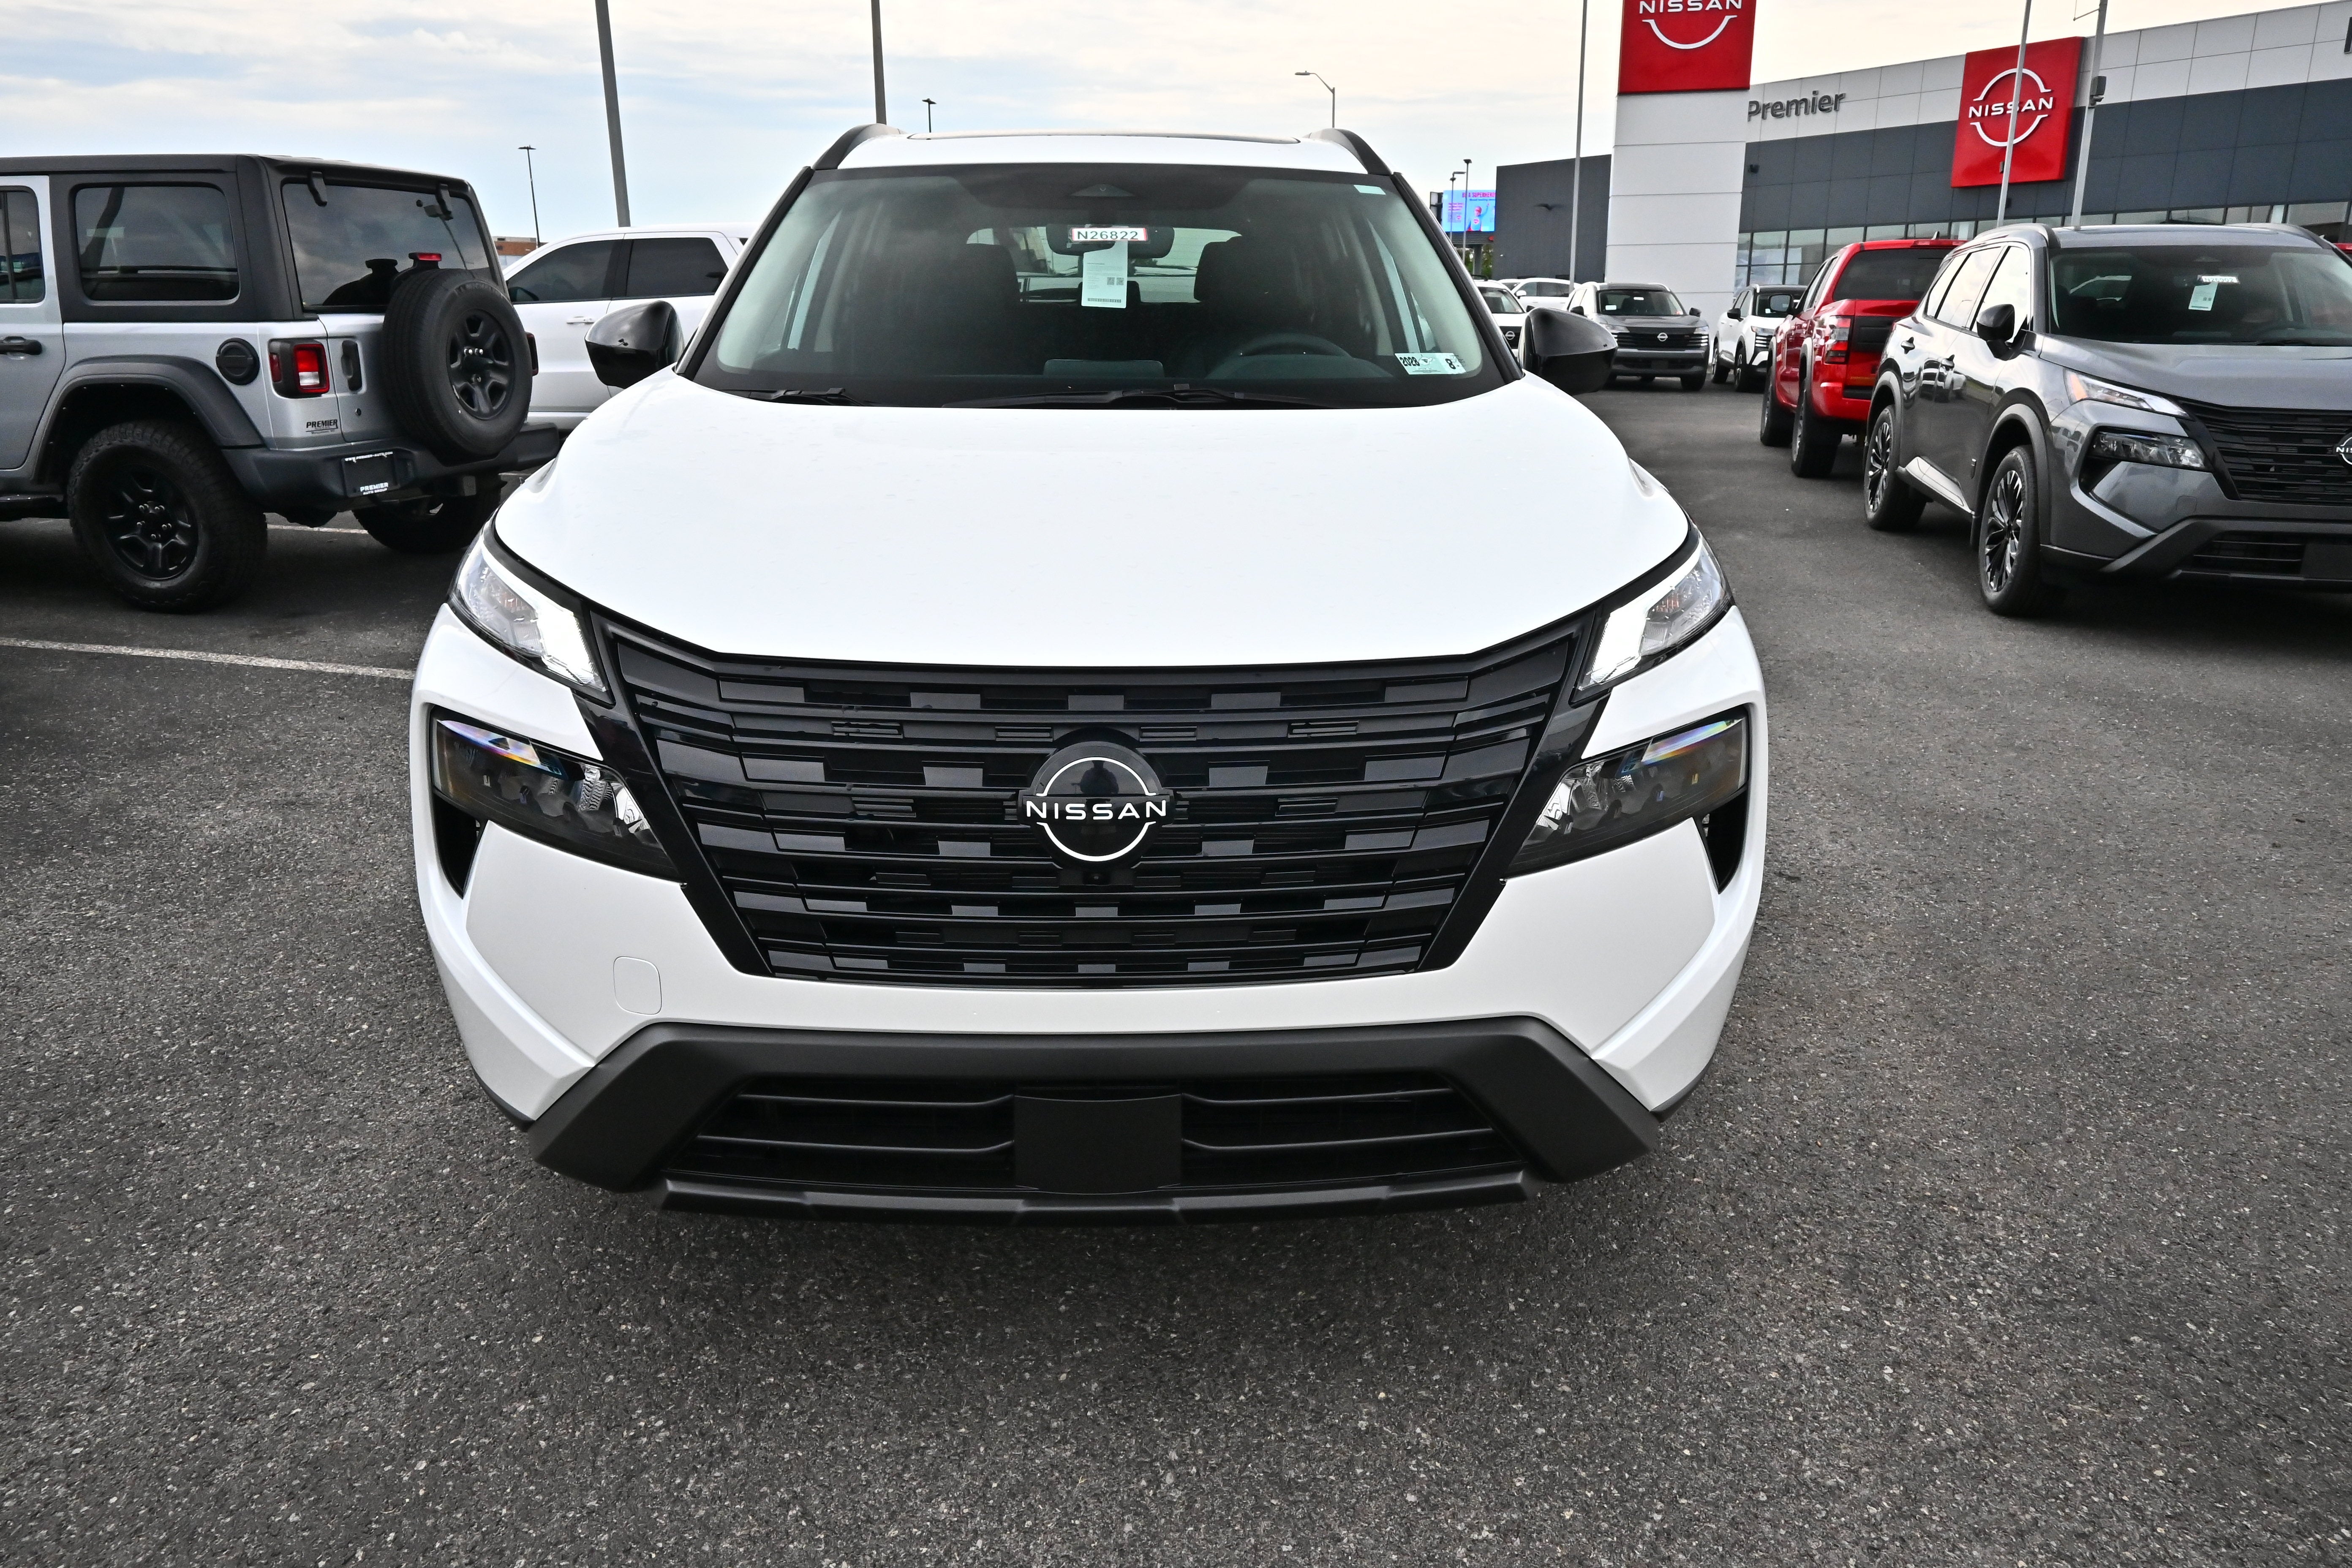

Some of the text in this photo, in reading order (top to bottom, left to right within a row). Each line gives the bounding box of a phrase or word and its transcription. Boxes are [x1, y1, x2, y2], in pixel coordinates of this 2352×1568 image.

[1639, 0, 1742, 14] NISSAN
[1747, 90, 1846, 122] Premier
[1968, 96, 2053, 118] NISSAN
[1077, 231, 1138, 240] N26822
[1399, 357, 1420, 366] 2028
[1445, 358, 1456, 370] 8
[306, 419, 338, 428] PREMIER
[360, 482, 388, 492] PREMIER
[1026, 800, 1166, 820] NISSAN
